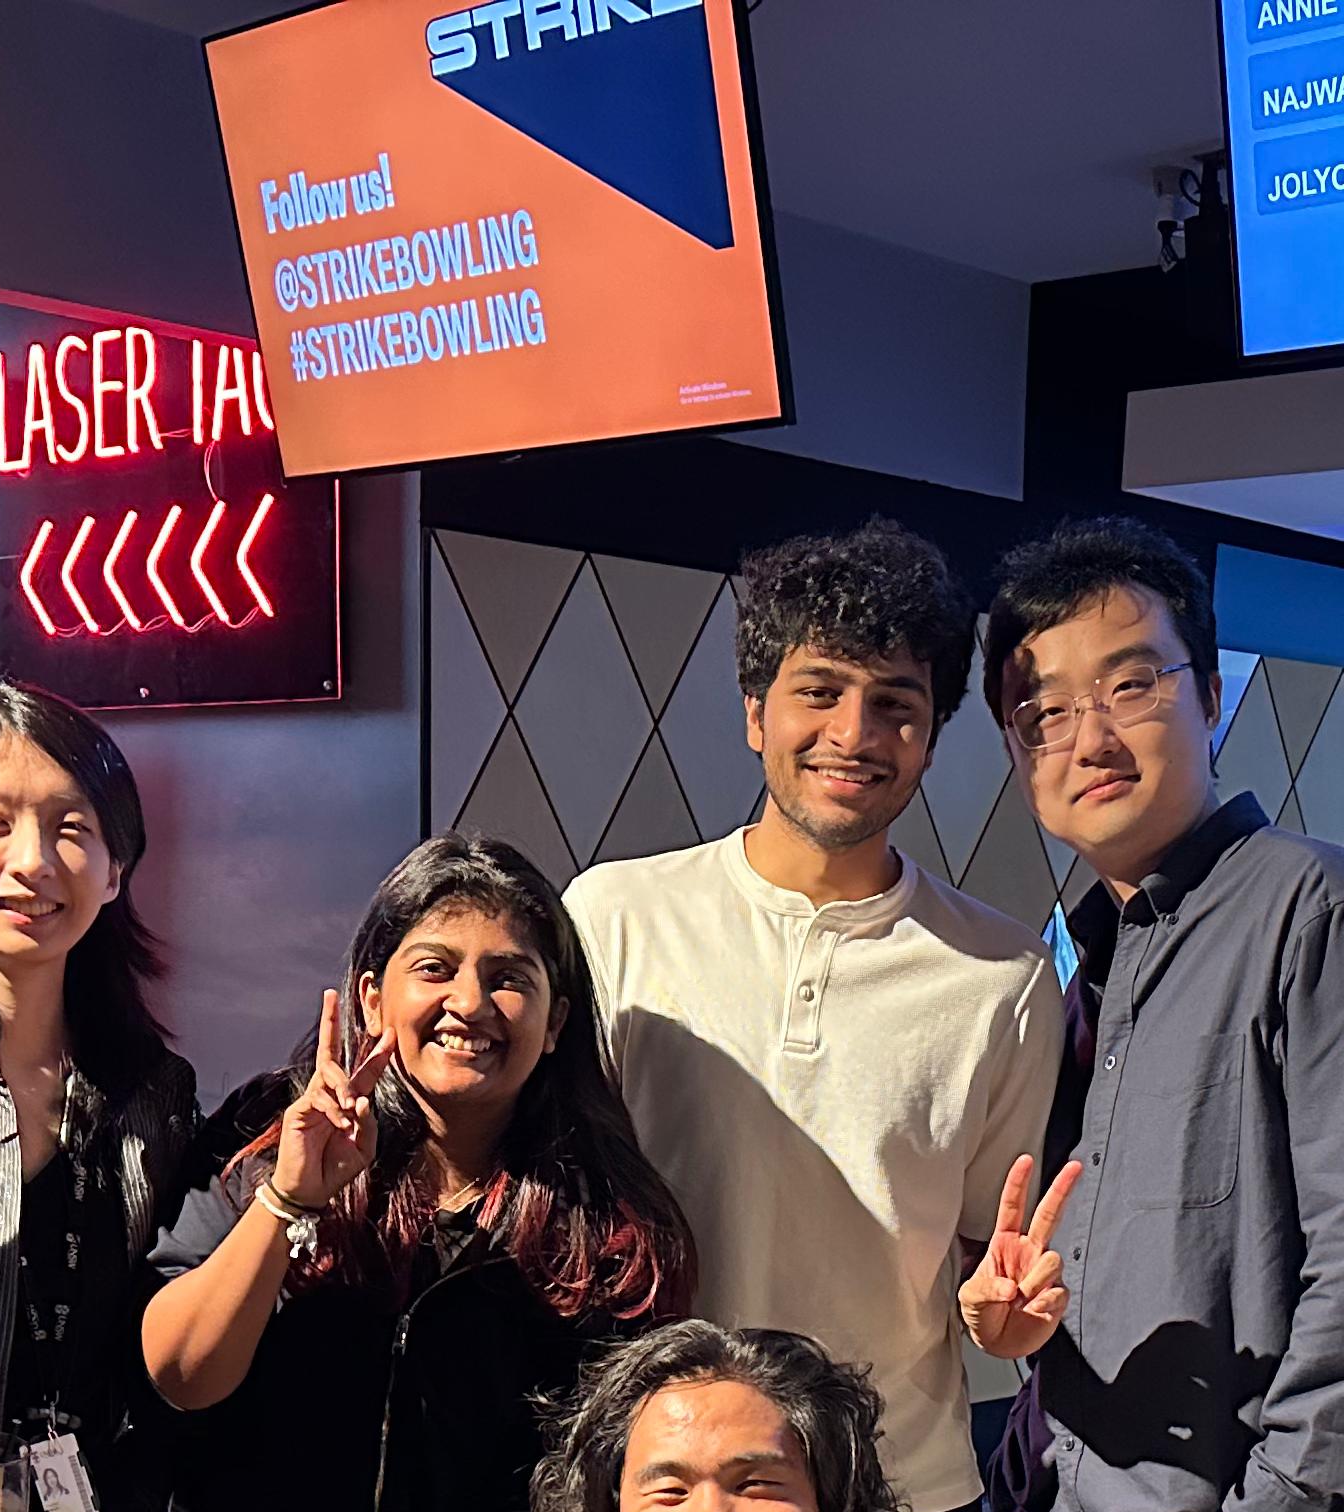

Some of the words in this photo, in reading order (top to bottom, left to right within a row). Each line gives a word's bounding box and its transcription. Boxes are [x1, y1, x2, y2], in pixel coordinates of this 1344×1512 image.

[260, 170, 346, 234] Follow
[349, 152, 395, 215] us!
[274, 209, 539, 313] @STRIKEBOWLING
[290, 288, 547, 382] #STRIKEBOWLING
